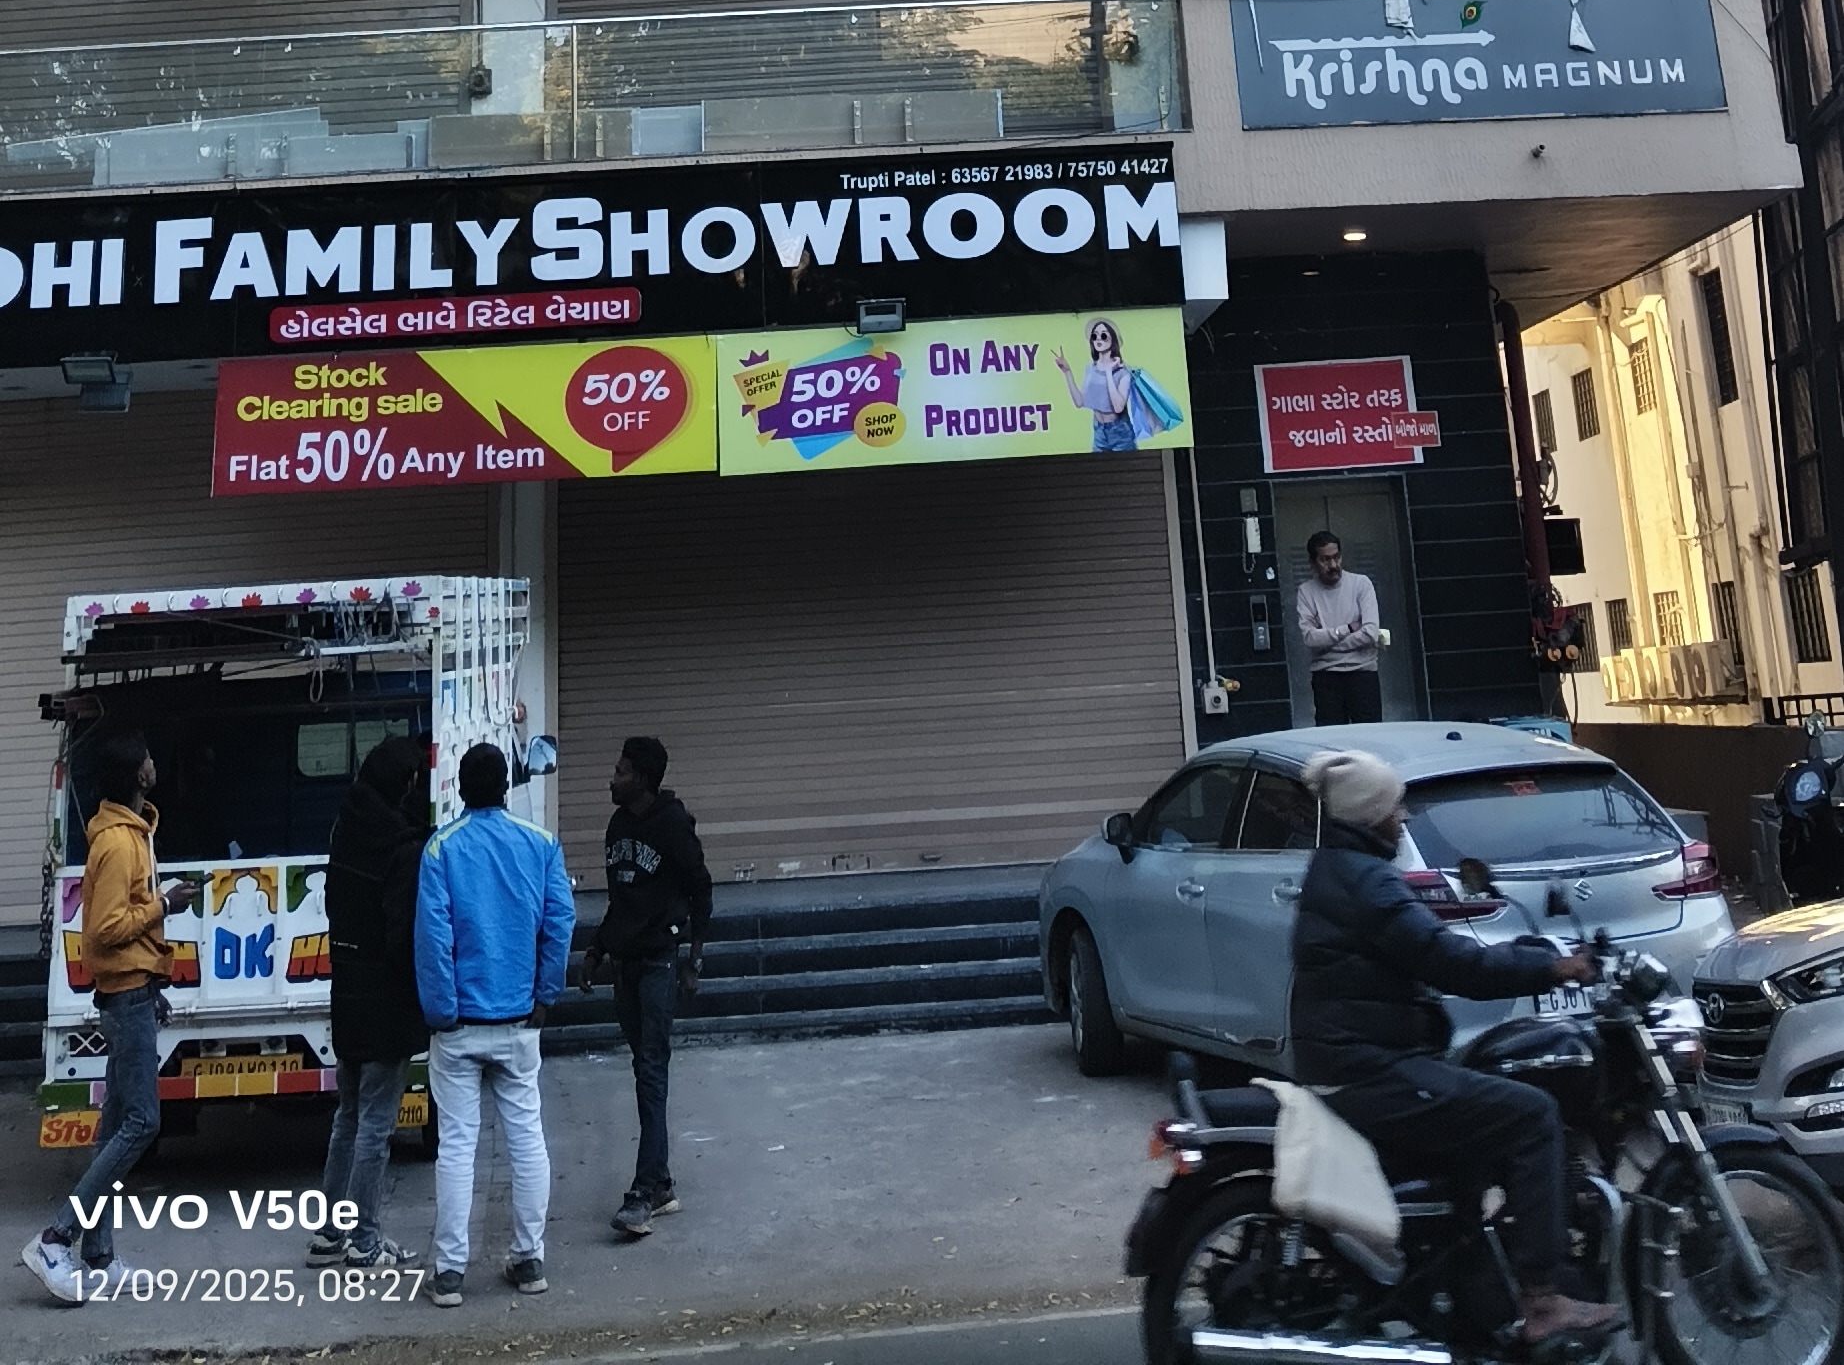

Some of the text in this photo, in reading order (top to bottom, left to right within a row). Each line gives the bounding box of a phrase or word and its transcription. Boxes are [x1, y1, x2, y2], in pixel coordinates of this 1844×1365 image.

[1282, 48, 1686, 110] Krishna MAGNUM
[840, 157, 1170, 192] Trupti Patel 63567 21983 75750 41427
[153, 181, 1181, 305] FAMILY SHOWROOM
[279, 295, 632, 340] હોલસેલ ભાવે રિટેલ વેચાણ
[294, 361, 389, 390] Stock
[581, 370, 671, 406] 50%
[743, 369, 783, 388] SPECIAL
[746, 380, 777, 397] OFFER
[790, 363, 882, 403] 50%
[236, 387, 444, 424] Clearing sale
[1272, 385, 1404, 414] ગાભા સ્ટોર તરફ
[603, 409, 652, 433] OFF
[791, 402, 851, 430] OFF
[864, 413, 897, 427] SHOP
[866, 425, 895, 438] NOW
[1288, 416, 1393, 448] જવાનો રસ્તો
[228, 427, 547, 484] Flat 50% Any Item
